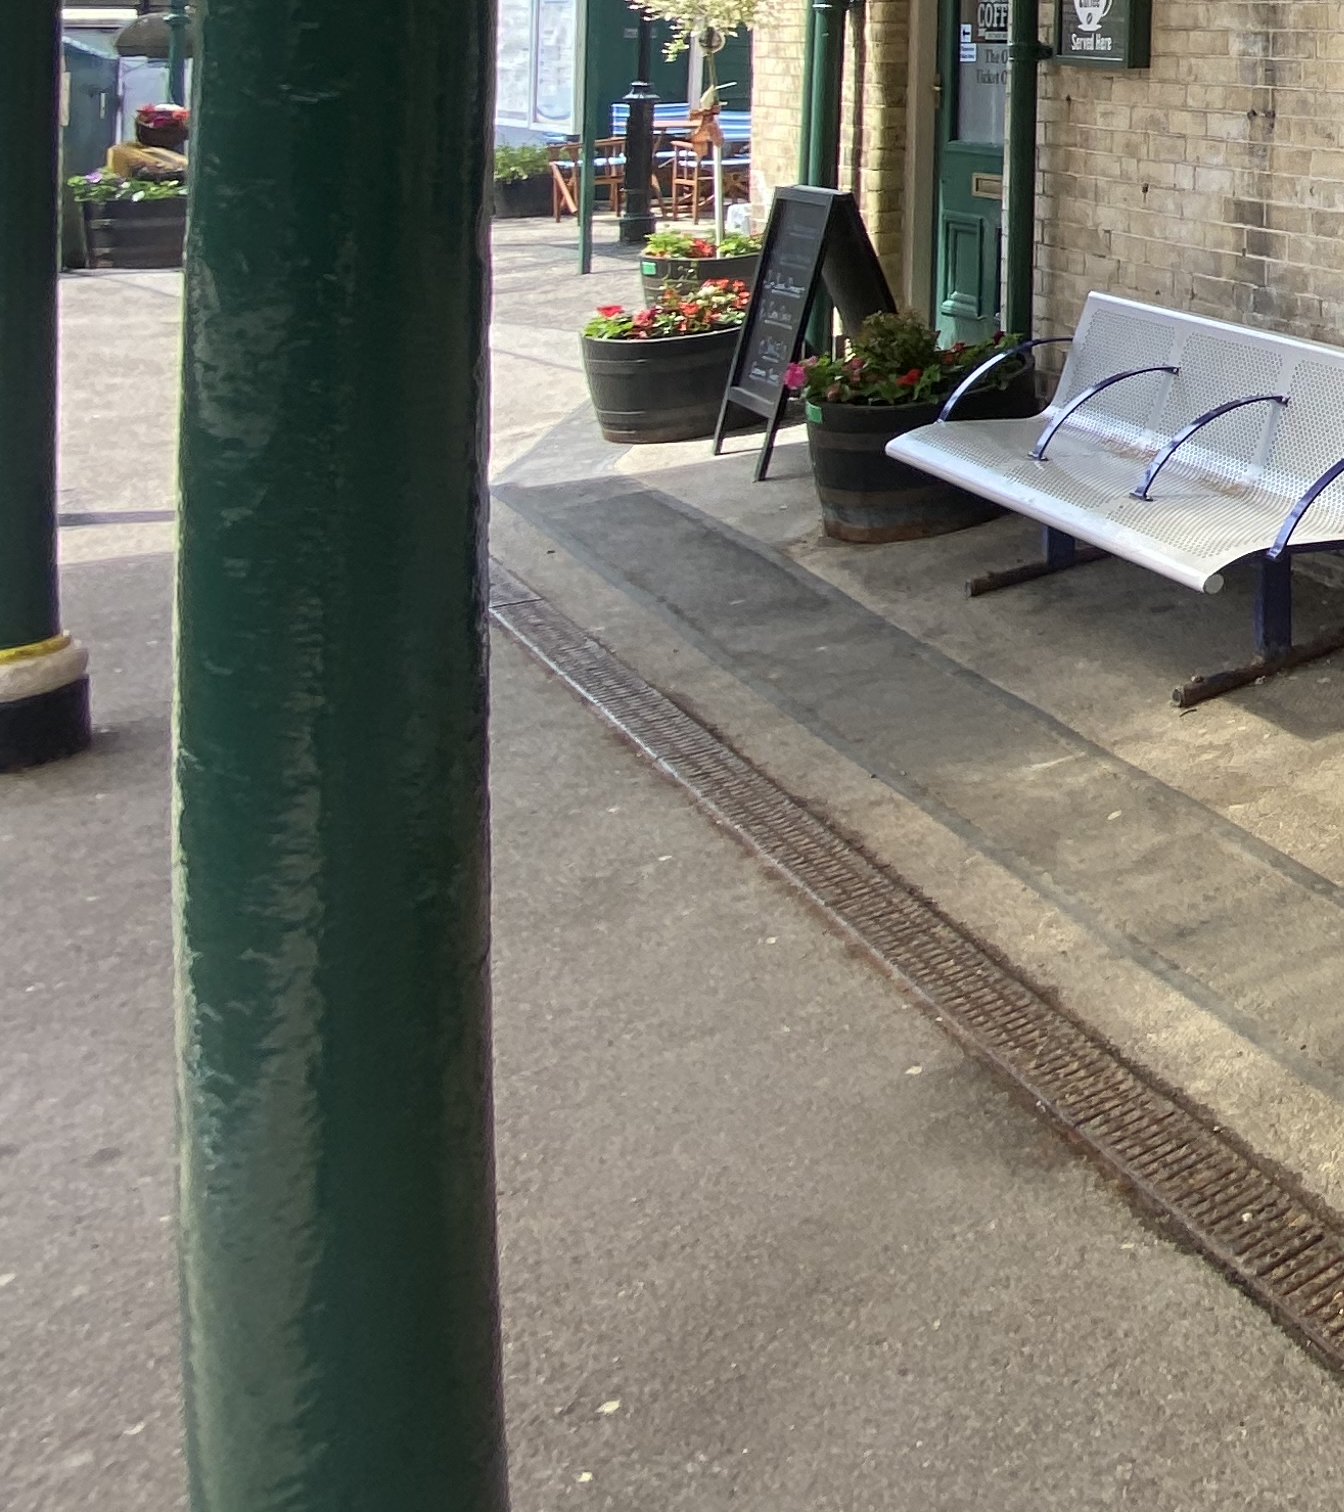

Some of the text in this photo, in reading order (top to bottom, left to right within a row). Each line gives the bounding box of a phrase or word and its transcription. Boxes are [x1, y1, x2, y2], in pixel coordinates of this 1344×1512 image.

[977, 2, 1008, 28] COFF
[1071, 33, 1112, 51] Served Here
